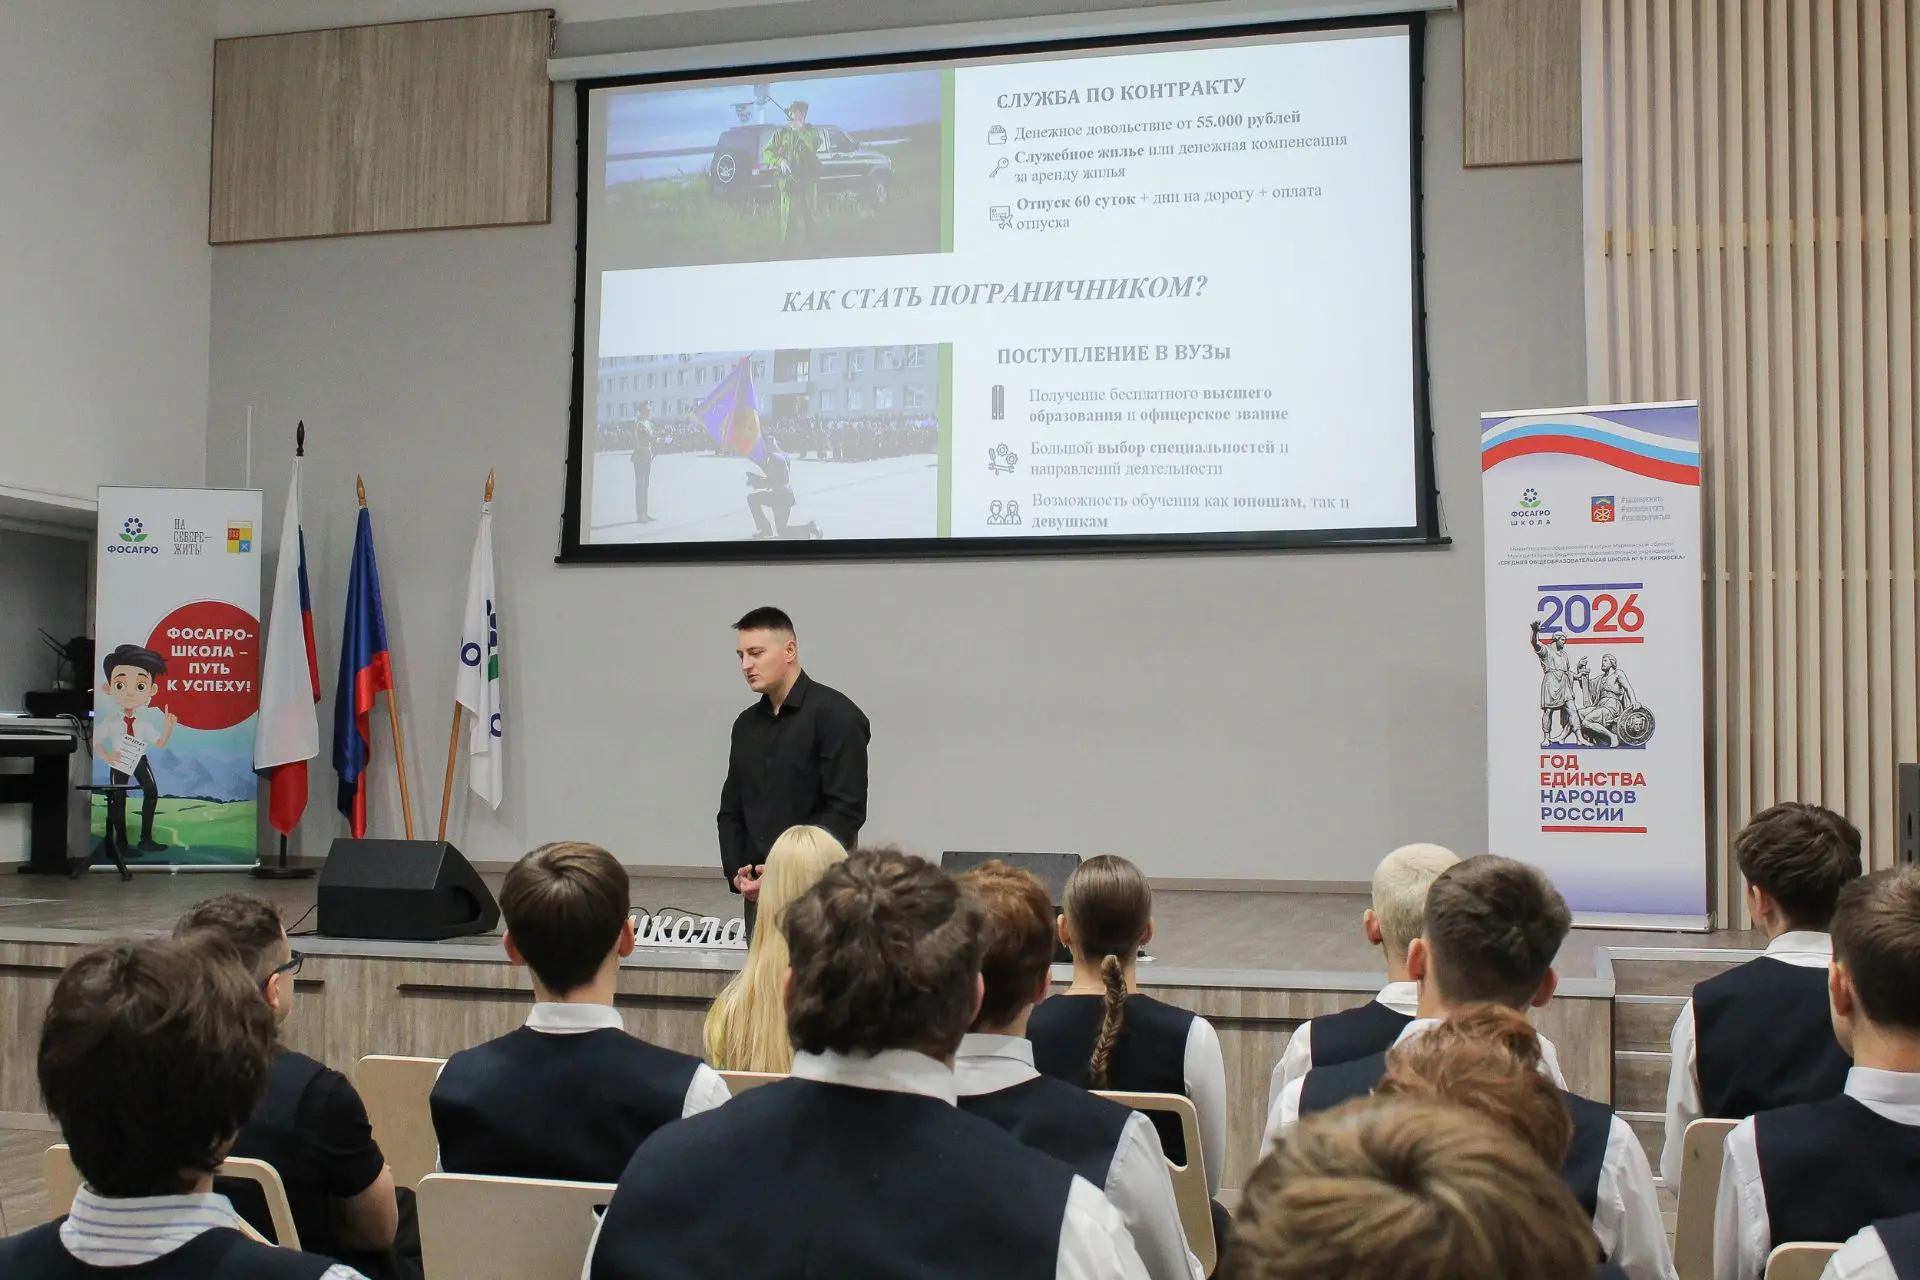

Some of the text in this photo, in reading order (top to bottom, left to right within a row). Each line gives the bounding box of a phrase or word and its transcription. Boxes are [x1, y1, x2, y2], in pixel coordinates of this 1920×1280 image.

[997, 78, 1246, 109] СЛУЖБА ПО КОНТРАКТУ
[1014, 110, 1300, 141] Денежное довольствие от 55.000 рублей
[1015, 133, 1347, 164] Служебное жилье или денежная компенсация
[1015, 166, 1125, 184] за аренду жилья
[1017, 195, 1071, 213] Отпуск
[1074, 194, 1090, 208] 60
[1094, 193, 1136, 209] суток
[1153, 191, 1180, 205] дни
[1183, 189, 1200, 202] на
[1204, 187, 1254, 204] дорогу
[1272, 184, 1322, 199] оплата
[1016, 216, 1070, 232] отпуска
[781, 275, 1208, 313] КАК СТАТЬ ПОГРАНИЧНИКОМ?
[997, 344, 1231, 364] ПОСТУПЛЕНИЕ В ВУЗы
[1029, 386, 1272, 404] Получение бесплатного высшего
[1029, 406, 1288, 424] образования и офицерское звание
[1030, 440, 1289, 457] Большой выбор специальностей и
[1030, 461, 1223, 478] направлений деятельности
[1032, 493, 1350, 511] Возможность обучения как юношам, так и
[1031, 514, 1109, 530] девушкам
[1511, 510, 1550, 518] ФОСАГРО
[174, 519, 185, 529] НА
[107, 545, 158, 554] ФОСАГРО
[1537, 594, 1644, 633] 2026
[167, 628, 253, 641] ФОСАГРО-
[171, 646, 234, 658] ШКОЛА
[188, 662, 230, 675] ПУТЬ
[167, 679, 251, 692] К УСПЕХУ!
[1540, 755, 1579, 770] ГОД
[1540, 772, 1646, 788] ЕДИНСТВА
[1541, 790, 1637, 805] НАРОДОВ
[1541, 807, 1624, 821] РОССИИ
